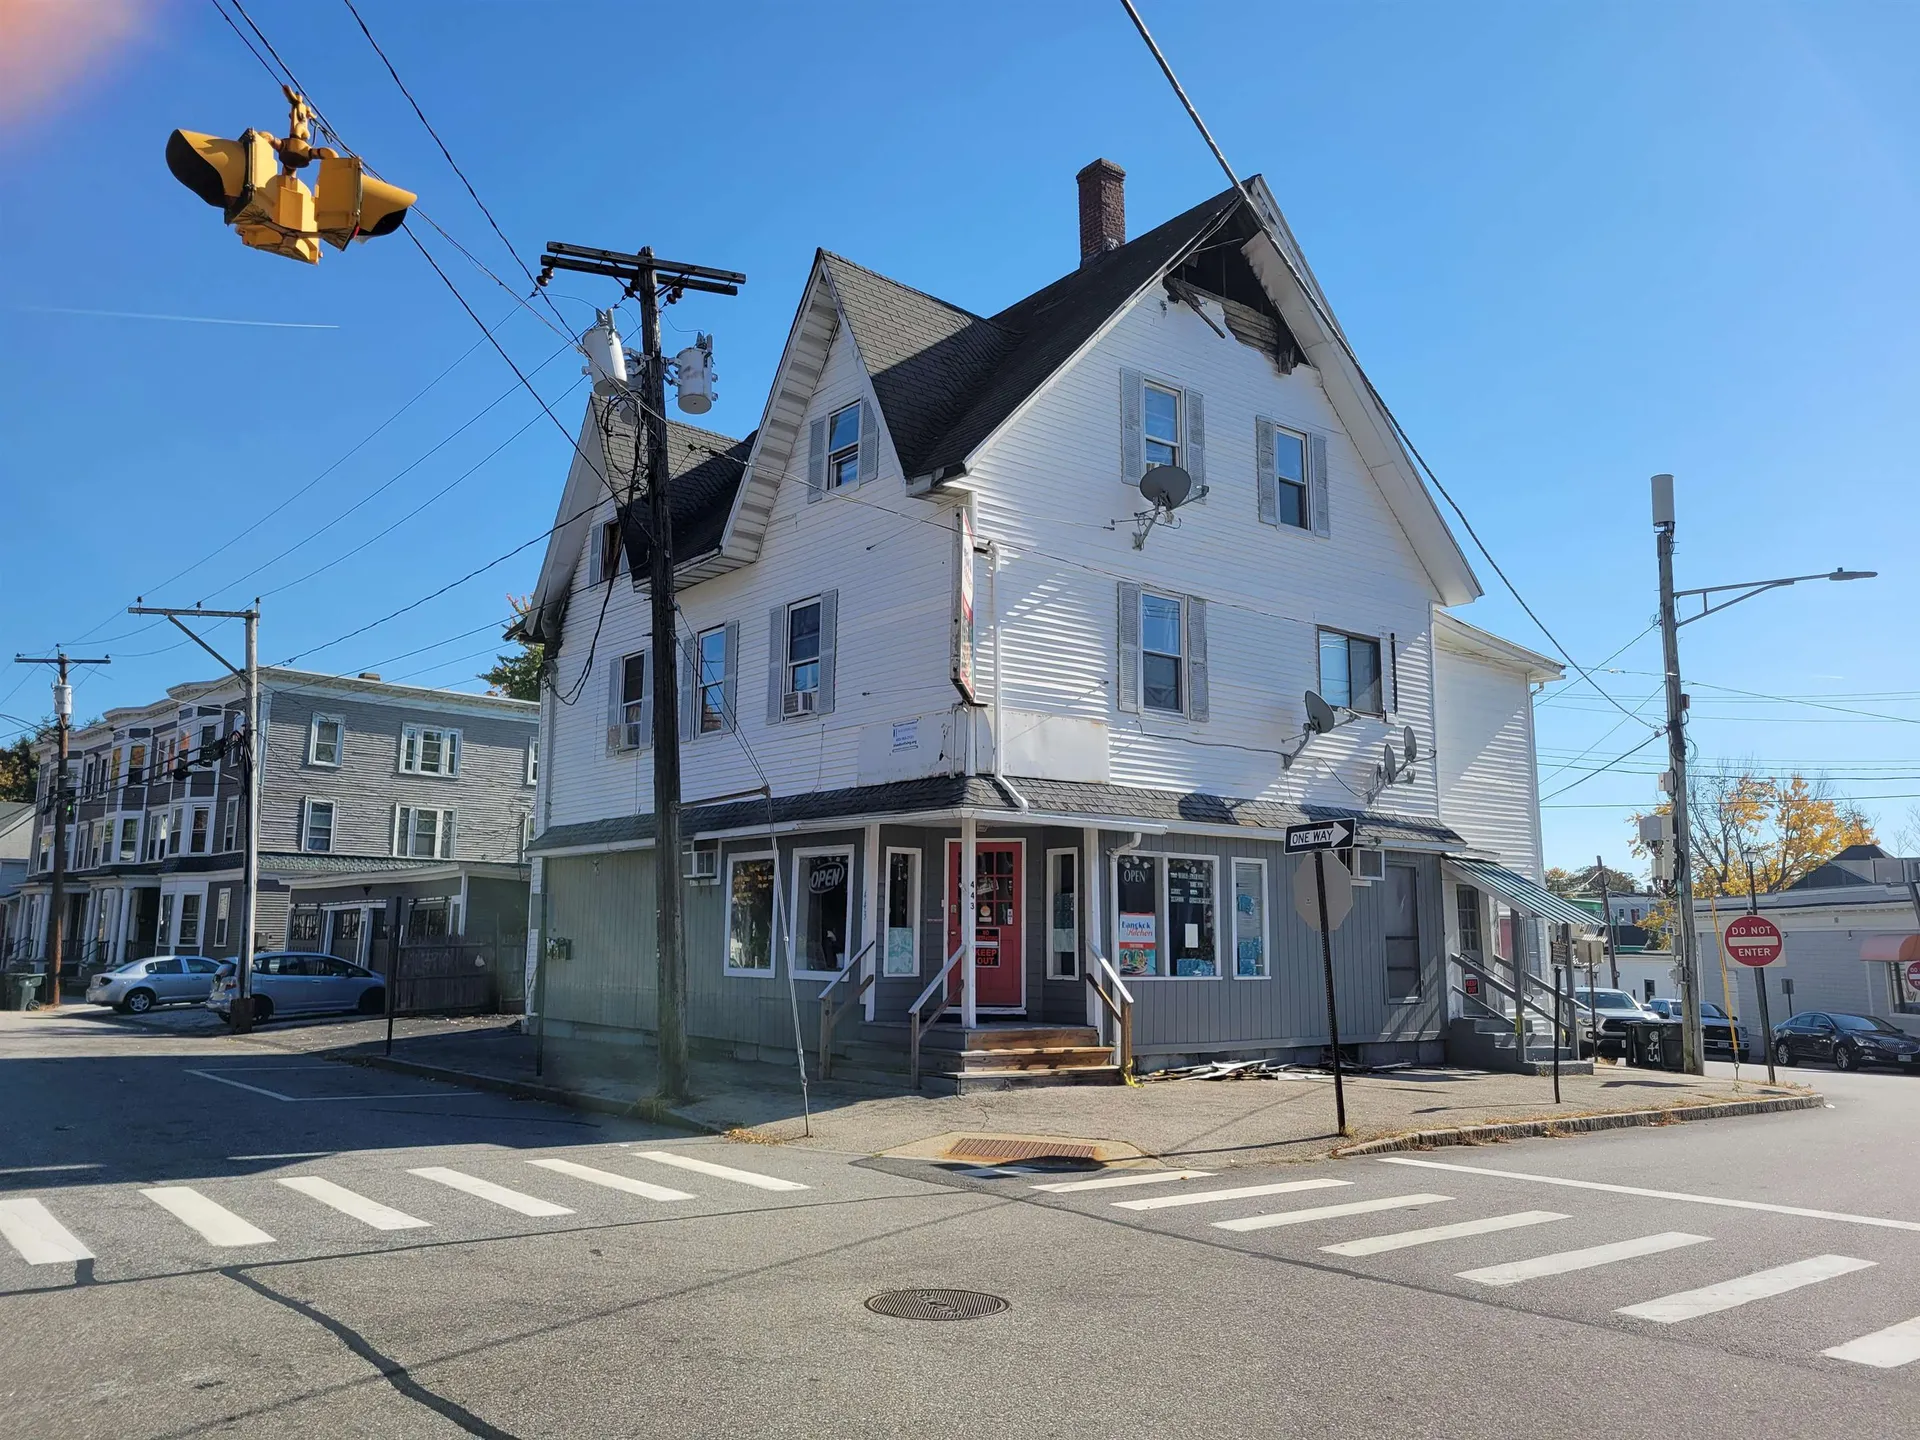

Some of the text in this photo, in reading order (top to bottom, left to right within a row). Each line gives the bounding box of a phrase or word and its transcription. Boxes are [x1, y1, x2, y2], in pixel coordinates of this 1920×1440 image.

[1292, 829, 1333, 845] ONE WAY
[811, 868, 840, 888] OPEN
[1124, 869, 1146, 883] OPEN
[1731, 926, 1771, 935] DO NOT
[1738, 947, 1771, 957] ENTER
[977, 957, 995, 965] OUT
